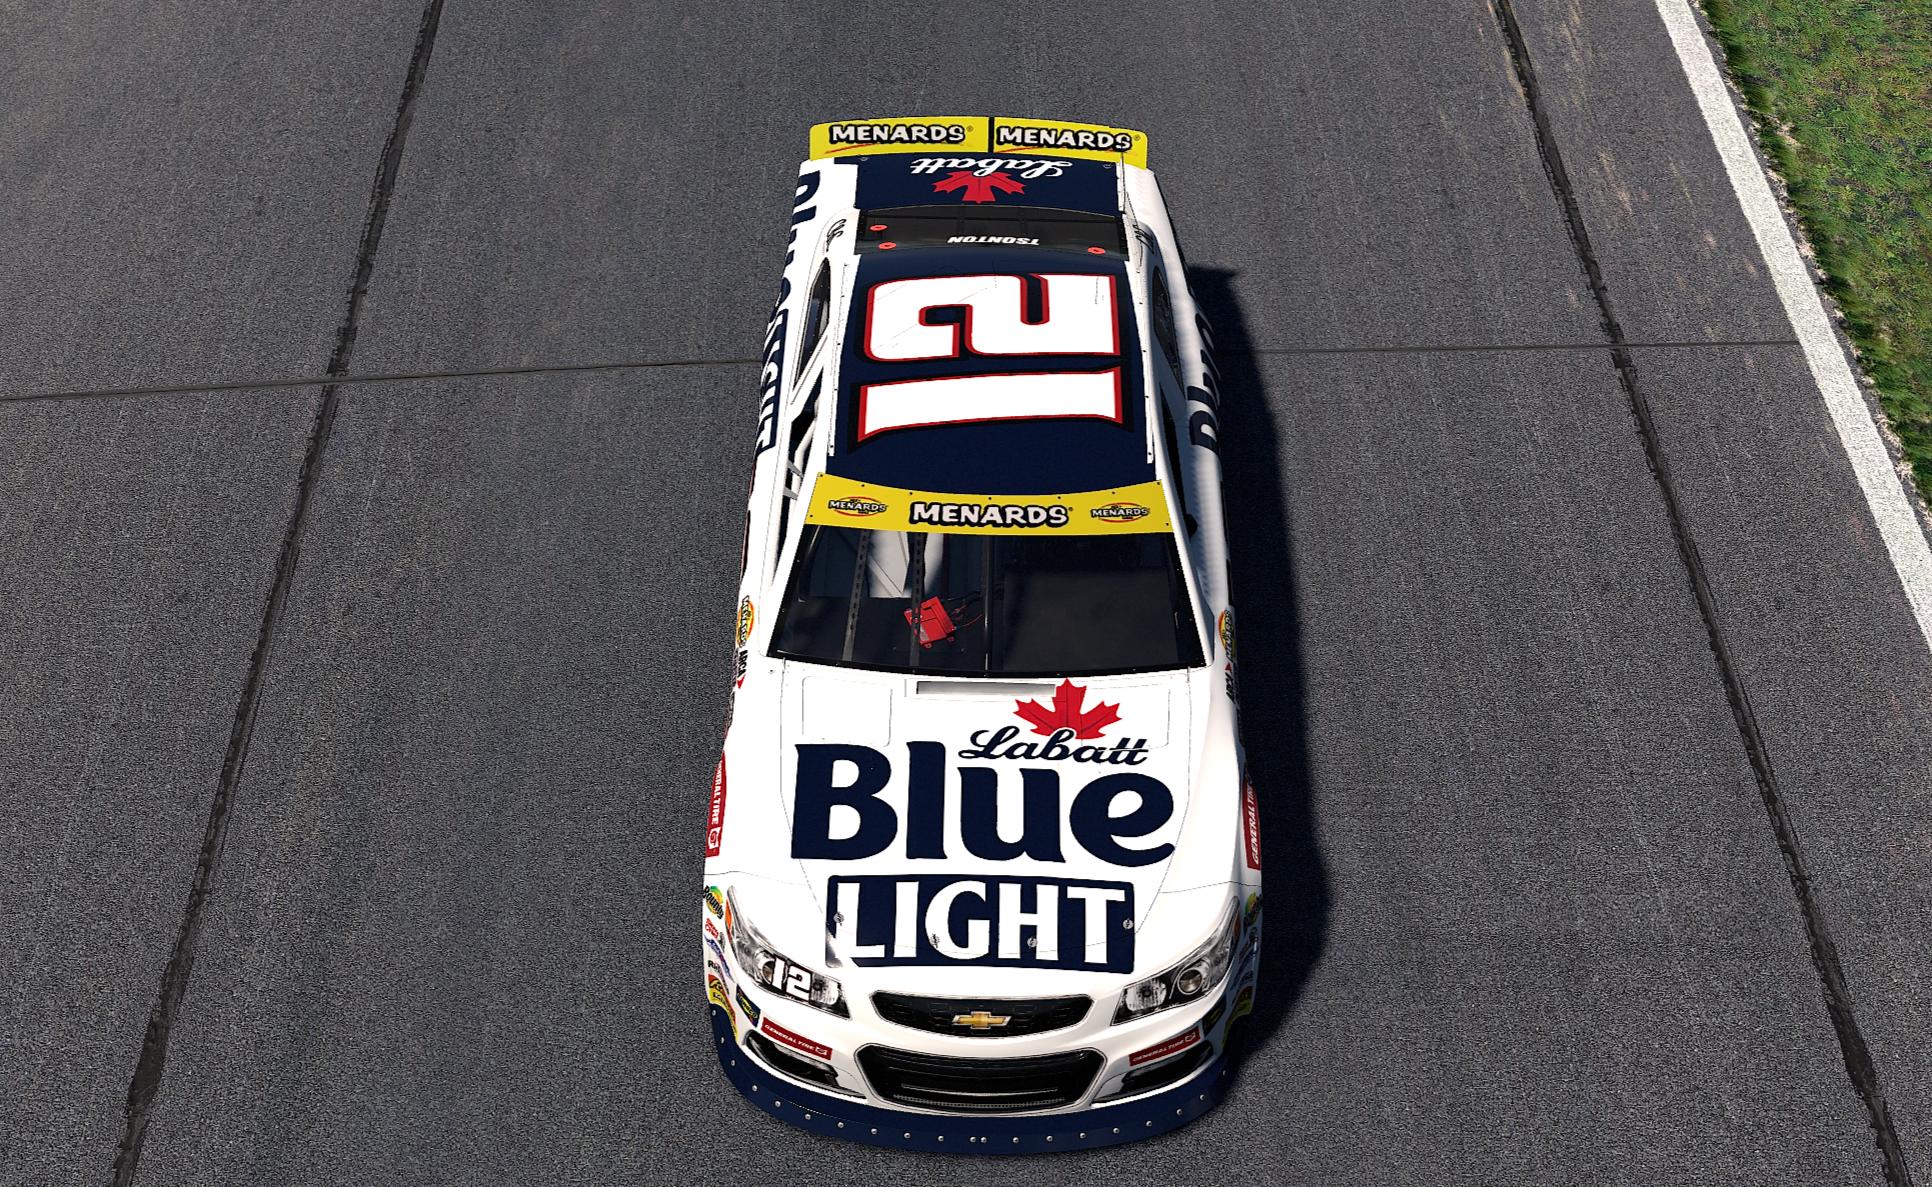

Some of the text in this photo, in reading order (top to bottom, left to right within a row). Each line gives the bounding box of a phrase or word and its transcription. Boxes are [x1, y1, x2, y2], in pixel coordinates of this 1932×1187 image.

[829, 124, 967, 145] MENARDS
[996, 126, 1132, 152] MENARDS
[911, 157, 1073, 178] Labatt
[828, 499, 887, 513] MENARDS
[909, 501, 1069, 527] MENARDS
[1090, 505, 1149, 518] MENARDS
[958, 725, 1150, 766] Labatt
[711, 798, 721, 825] TIRE
[791, 741, 1176, 868] Blue
[835, 880, 1127, 965] LIGHT
[770, 956, 813, 1002] 12
